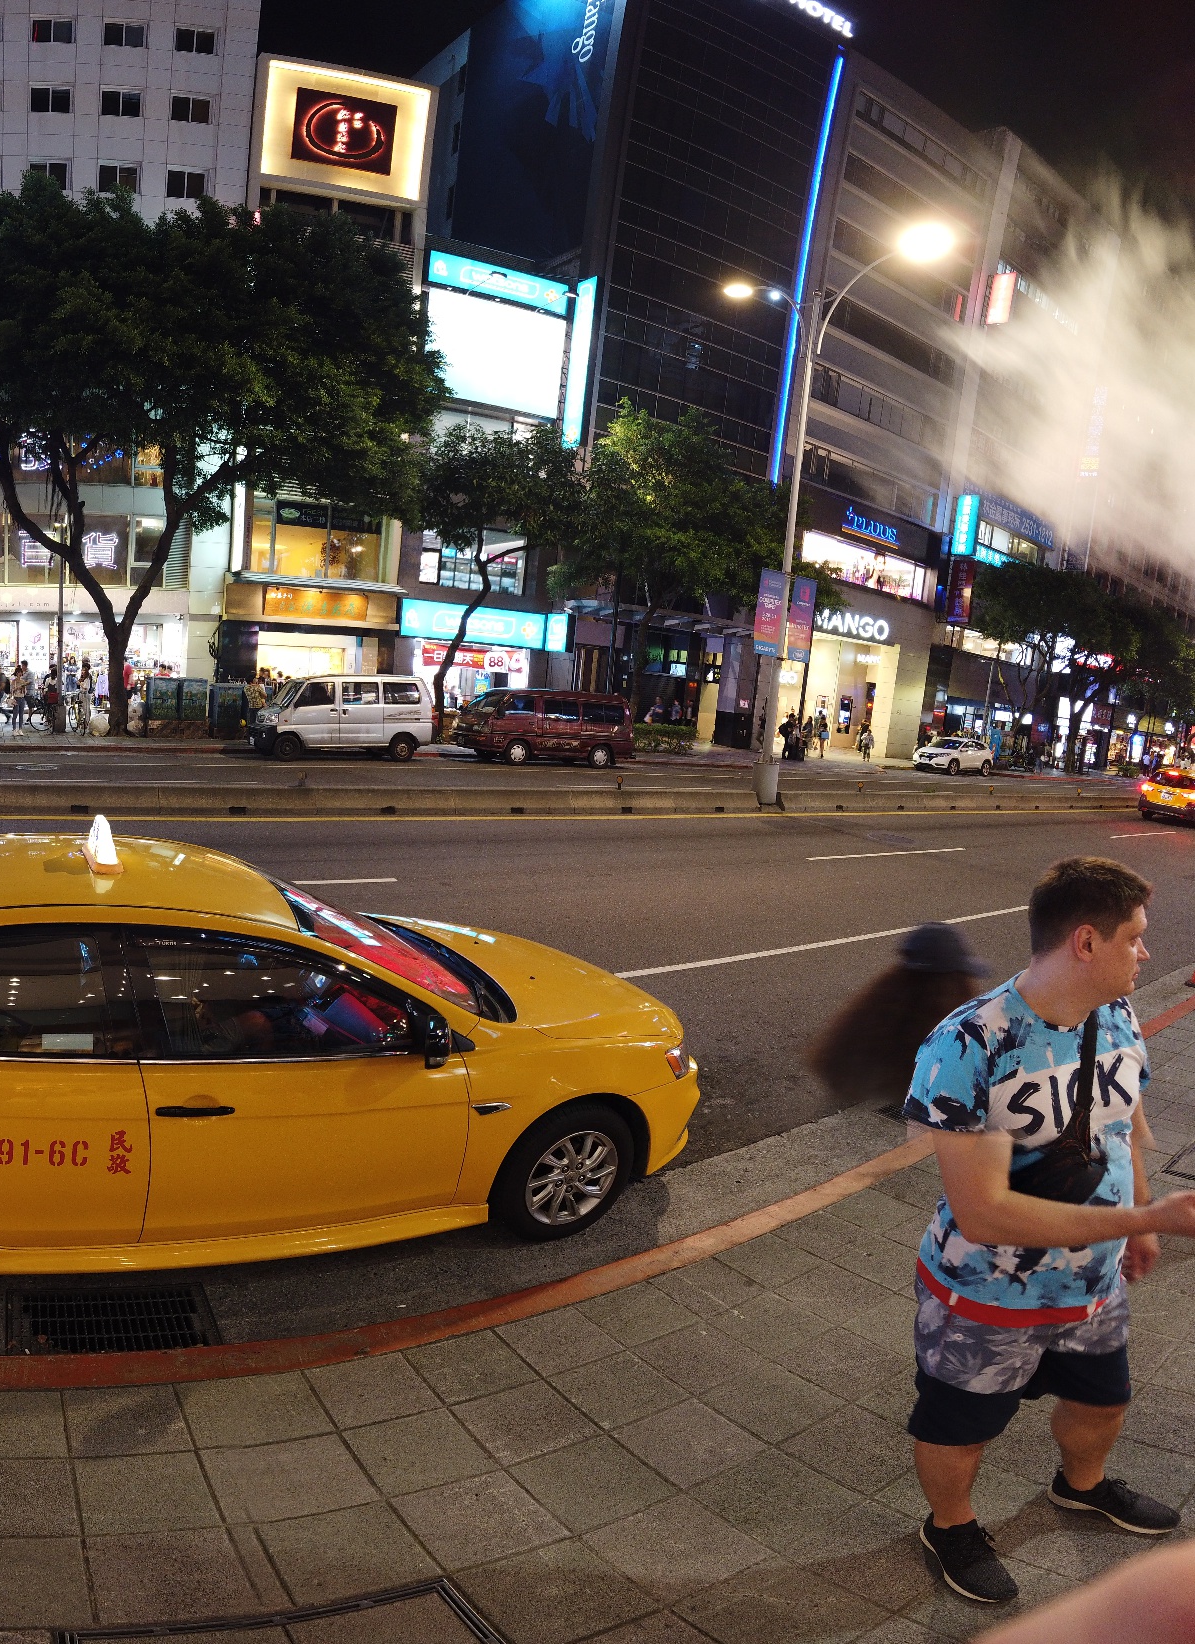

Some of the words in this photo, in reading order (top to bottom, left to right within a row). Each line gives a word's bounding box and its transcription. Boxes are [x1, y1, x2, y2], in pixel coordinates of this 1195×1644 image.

[572, 0, 600, 62] ango
[852, 514, 897, 542] PLUUS
[815, 608, 890, 641] MANGO
[488, 655, 504, 668] 88
[107, 1130, 134, 1175] 民敬
